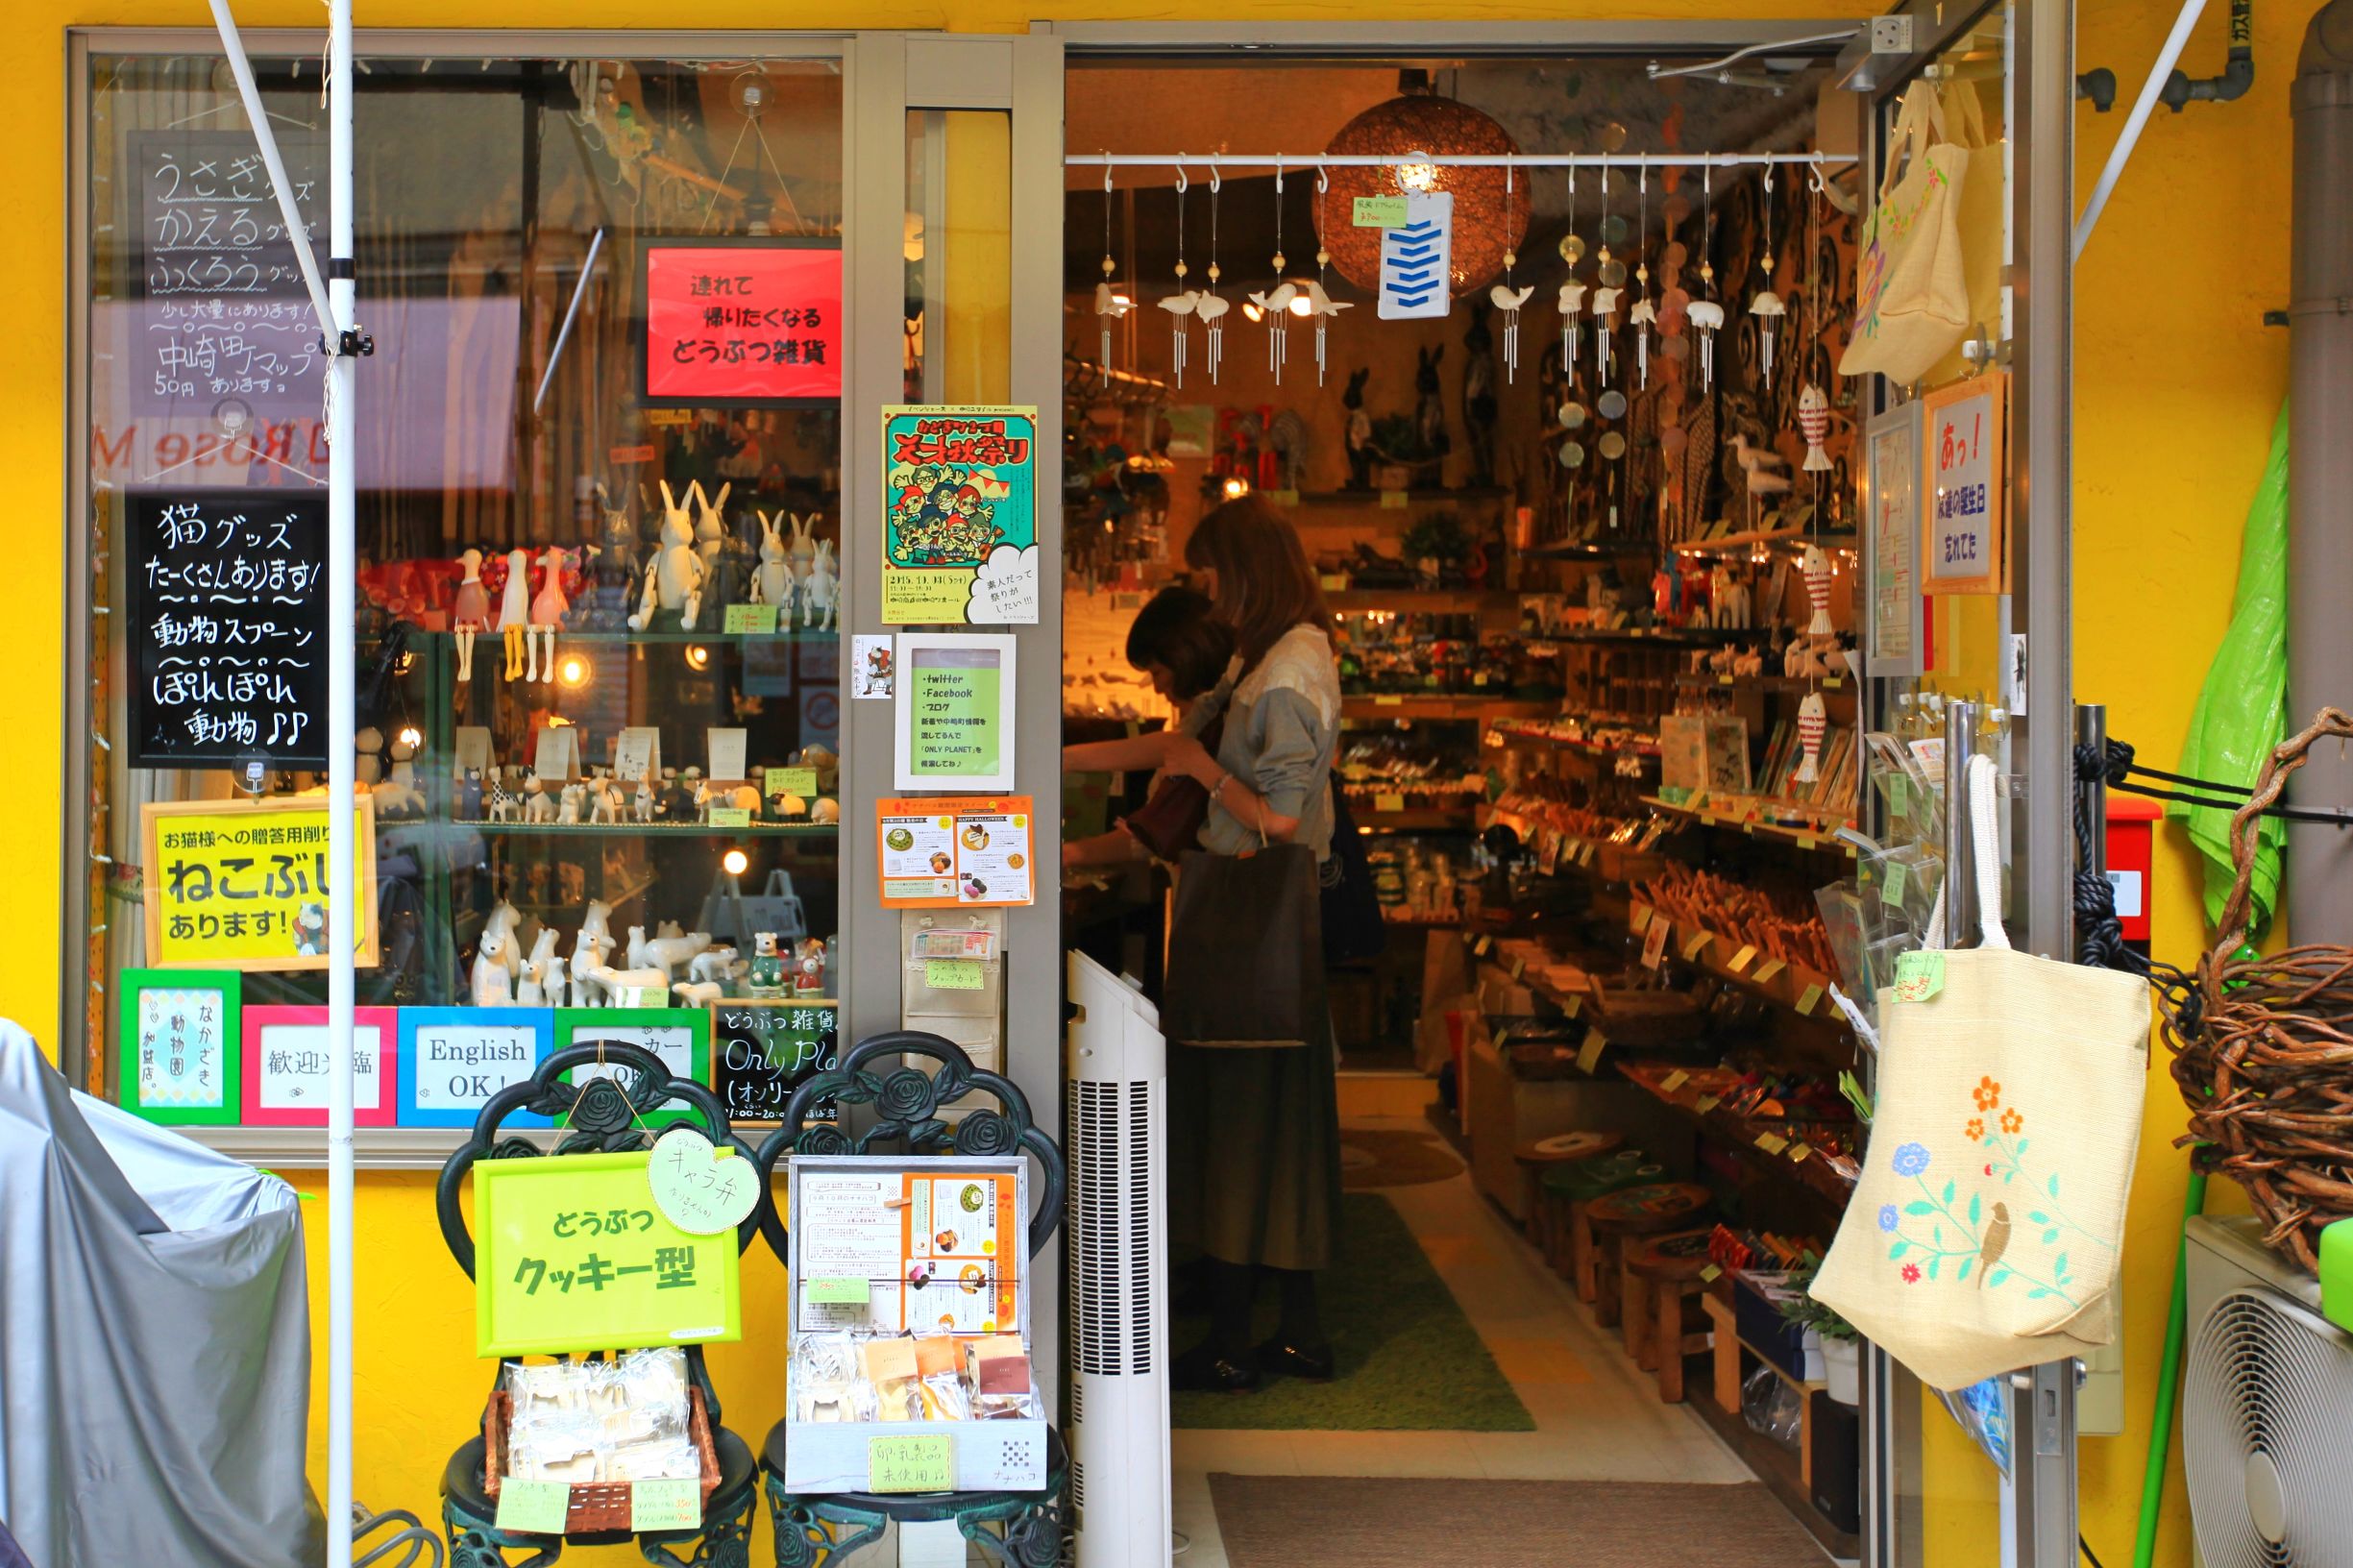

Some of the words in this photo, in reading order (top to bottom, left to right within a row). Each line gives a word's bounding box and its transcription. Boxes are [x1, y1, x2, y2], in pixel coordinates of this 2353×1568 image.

[155, 153, 315, 202] うさぎズ
[151, 255, 309, 288] ふくろうグッ
[691, 276, 753, 296] 連れて
[704, 307, 821, 328] 帰りたくなる
[159, 333, 318, 378] 中崎町マップ
[674, 339, 826, 365] どうぶつ雑貨
[154, 371, 194, 397] 50円
[1941, 412, 1981, 471] あっ!
[158, 502, 298, 550] 猫グッズ
[1945, 531, 1976, 563] 忘れてた
[991, 587, 1018, 602] 祭りが
[151, 612, 313, 649] 動物スプーン
[169, 910, 286, 940] あります!
[170, 1015, 185, 1076] 動物園
[199, 1005, 214, 1087] なかざき
[429, 1040, 527, 1065] English
[725, 1040, 785, 1080] Only
[669, 1148, 736, 1206] キャラ弁
[553, 1209, 654, 1237] どうぶつ
[514, 1245, 697, 1296] クッキー型
[993, 1470, 1036, 1484] ナナハコ
